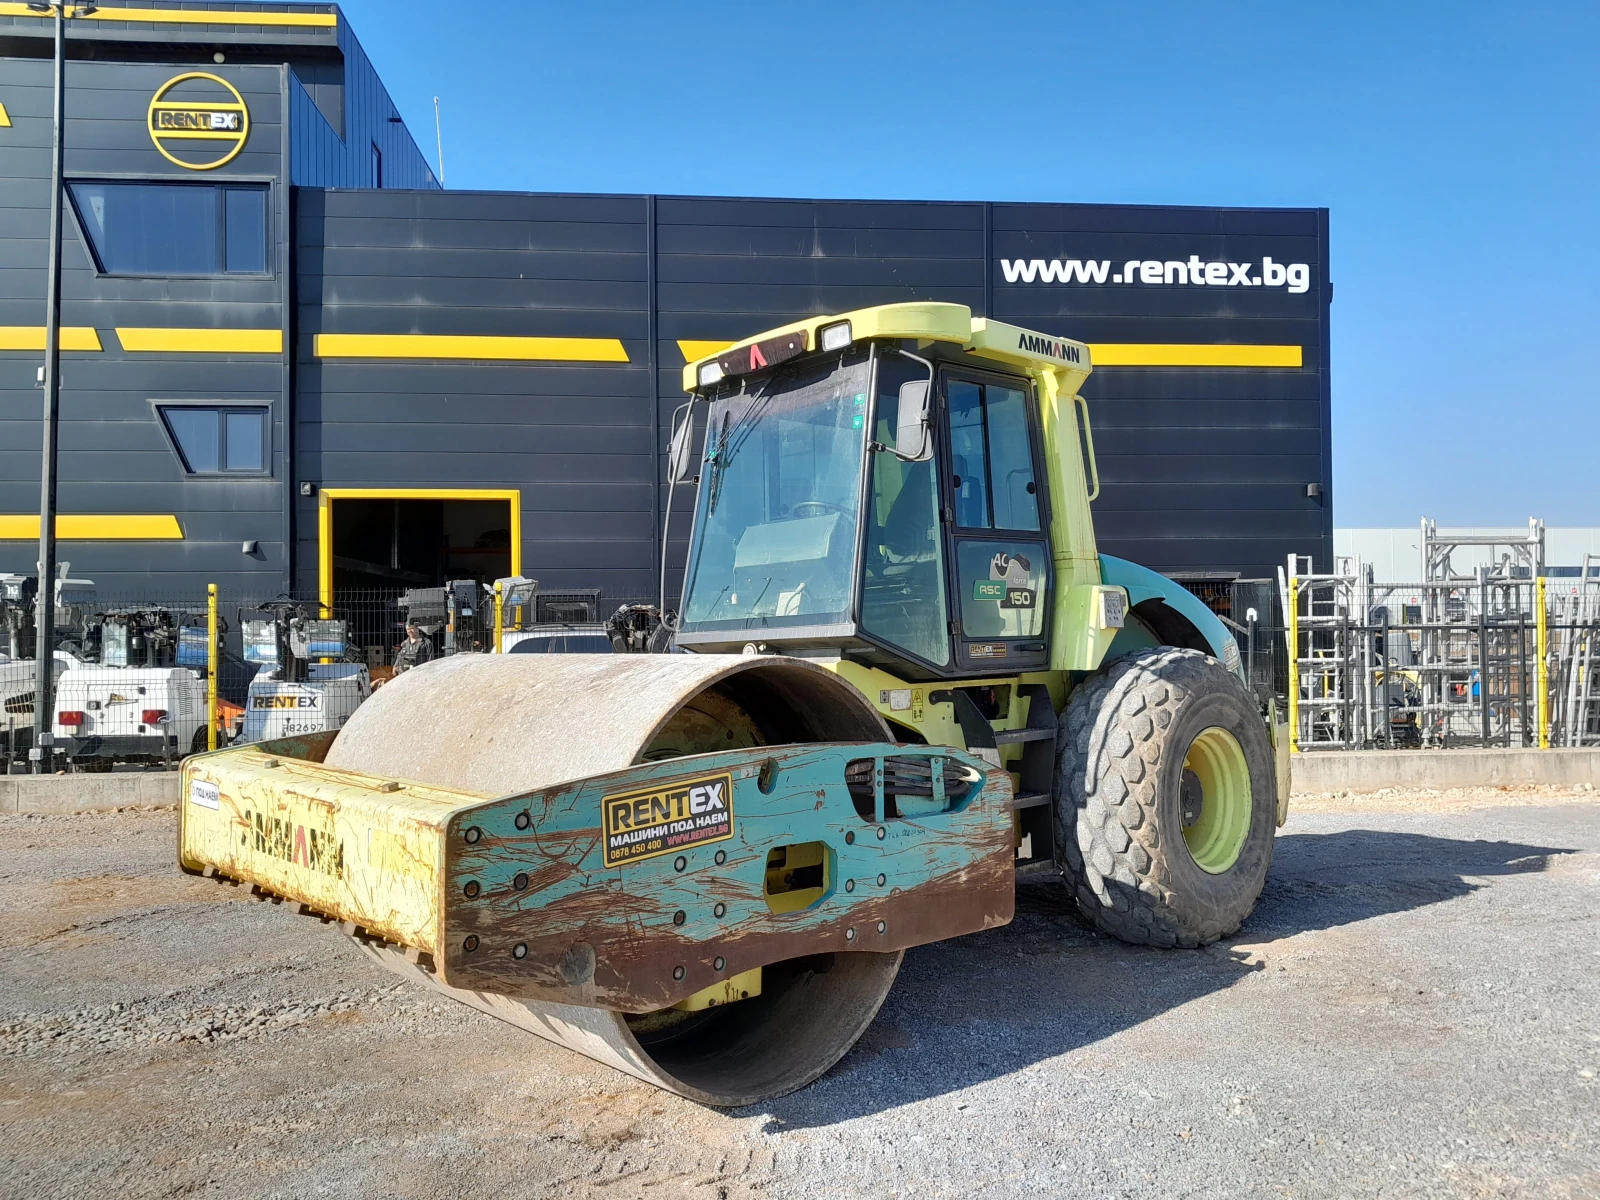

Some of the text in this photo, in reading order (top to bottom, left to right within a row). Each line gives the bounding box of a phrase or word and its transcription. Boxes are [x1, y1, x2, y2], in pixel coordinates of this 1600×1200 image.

[160, 112, 236, 129] RENTEX
[1018, 333, 1080, 364] AMMANN
[979, 585, 1001, 595] ASC
[1009, 591, 1030, 605] 150
[253, 696, 318, 708] RENTEX
[612, 782, 724, 831] RENTEX
[610, 811, 728, 848] МАШИНИ ПОД НАЕМ
[610, 839, 662, 860] 0878 450 400
